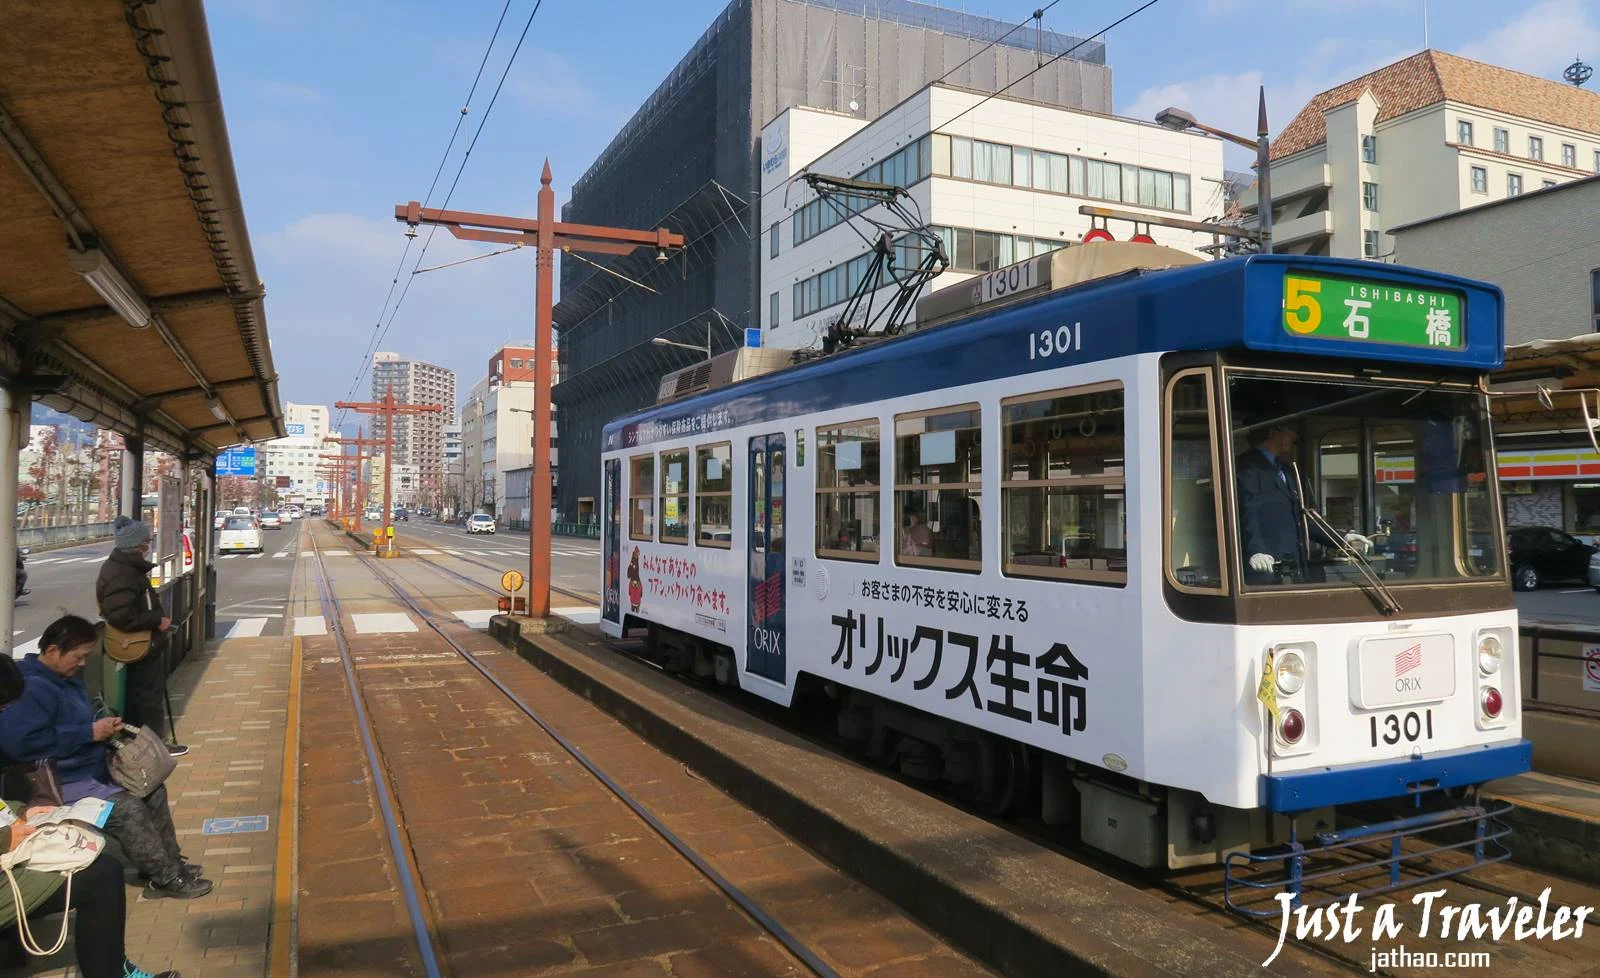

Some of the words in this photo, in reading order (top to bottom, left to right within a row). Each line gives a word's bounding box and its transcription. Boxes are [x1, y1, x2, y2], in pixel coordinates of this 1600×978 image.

[986, 260, 1031, 299] 1301
[1350, 285, 1446, 308] ISHIBASHI
[1285, 277, 1322, 334] 5
[1342, 299, 1452, 347] 石橋
[1029, 321, 1081, 361] 1301
[642, 553, 697, 580] みんなであなたの
[861, 578, 1029, 623] お客さまの不安を安心に変える
[754, 627, 781, 655] ORIX
[831, 609, 1089, 736] オリックス生命
[1395, 677, 1422, 692] ORIX
[1370, 709, 1433, 748] 1301
